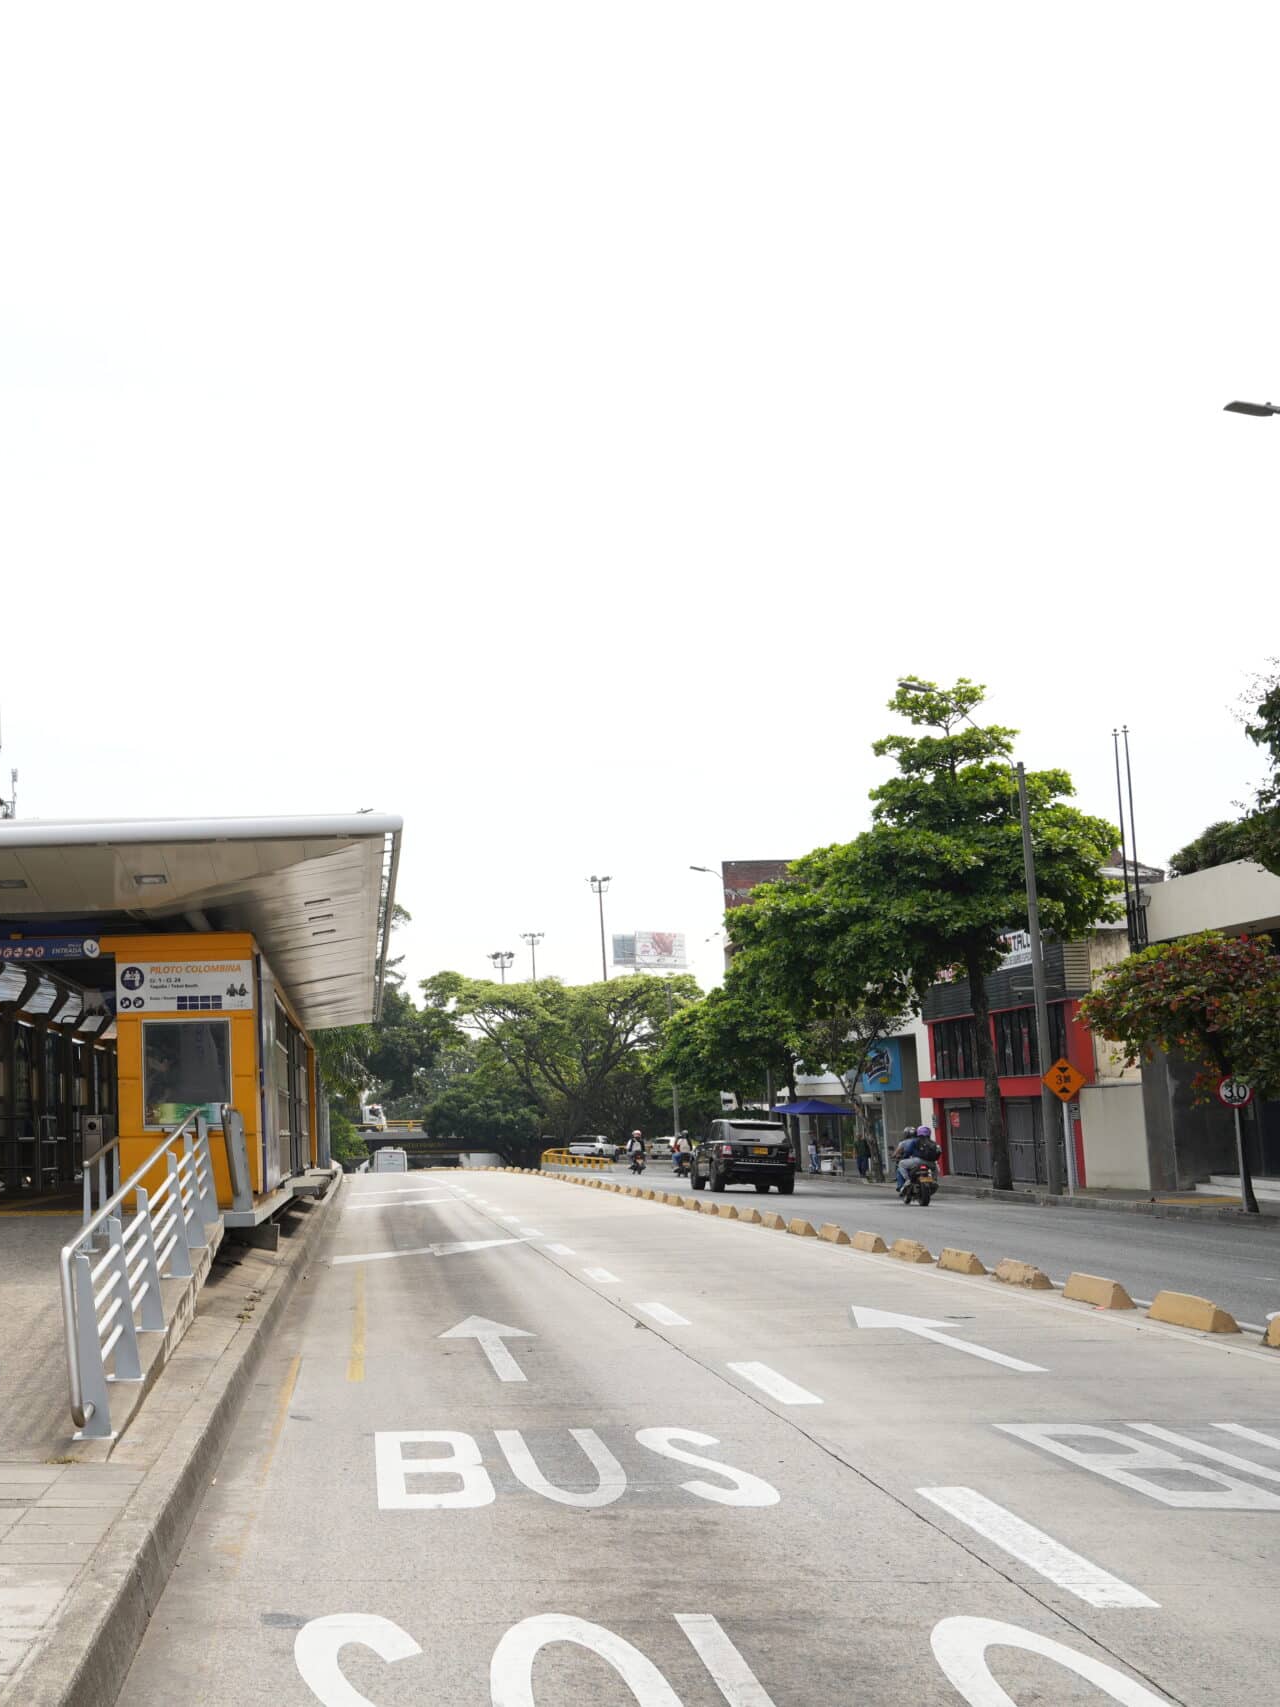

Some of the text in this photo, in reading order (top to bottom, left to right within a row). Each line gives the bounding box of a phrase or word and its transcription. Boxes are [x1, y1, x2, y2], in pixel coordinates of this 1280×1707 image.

[150, 963, 241, 974] PILOTO COLOMBINA
[1223, 1082, 1247, 1099] 30
[374, 1428, 781, 1510] BUS
